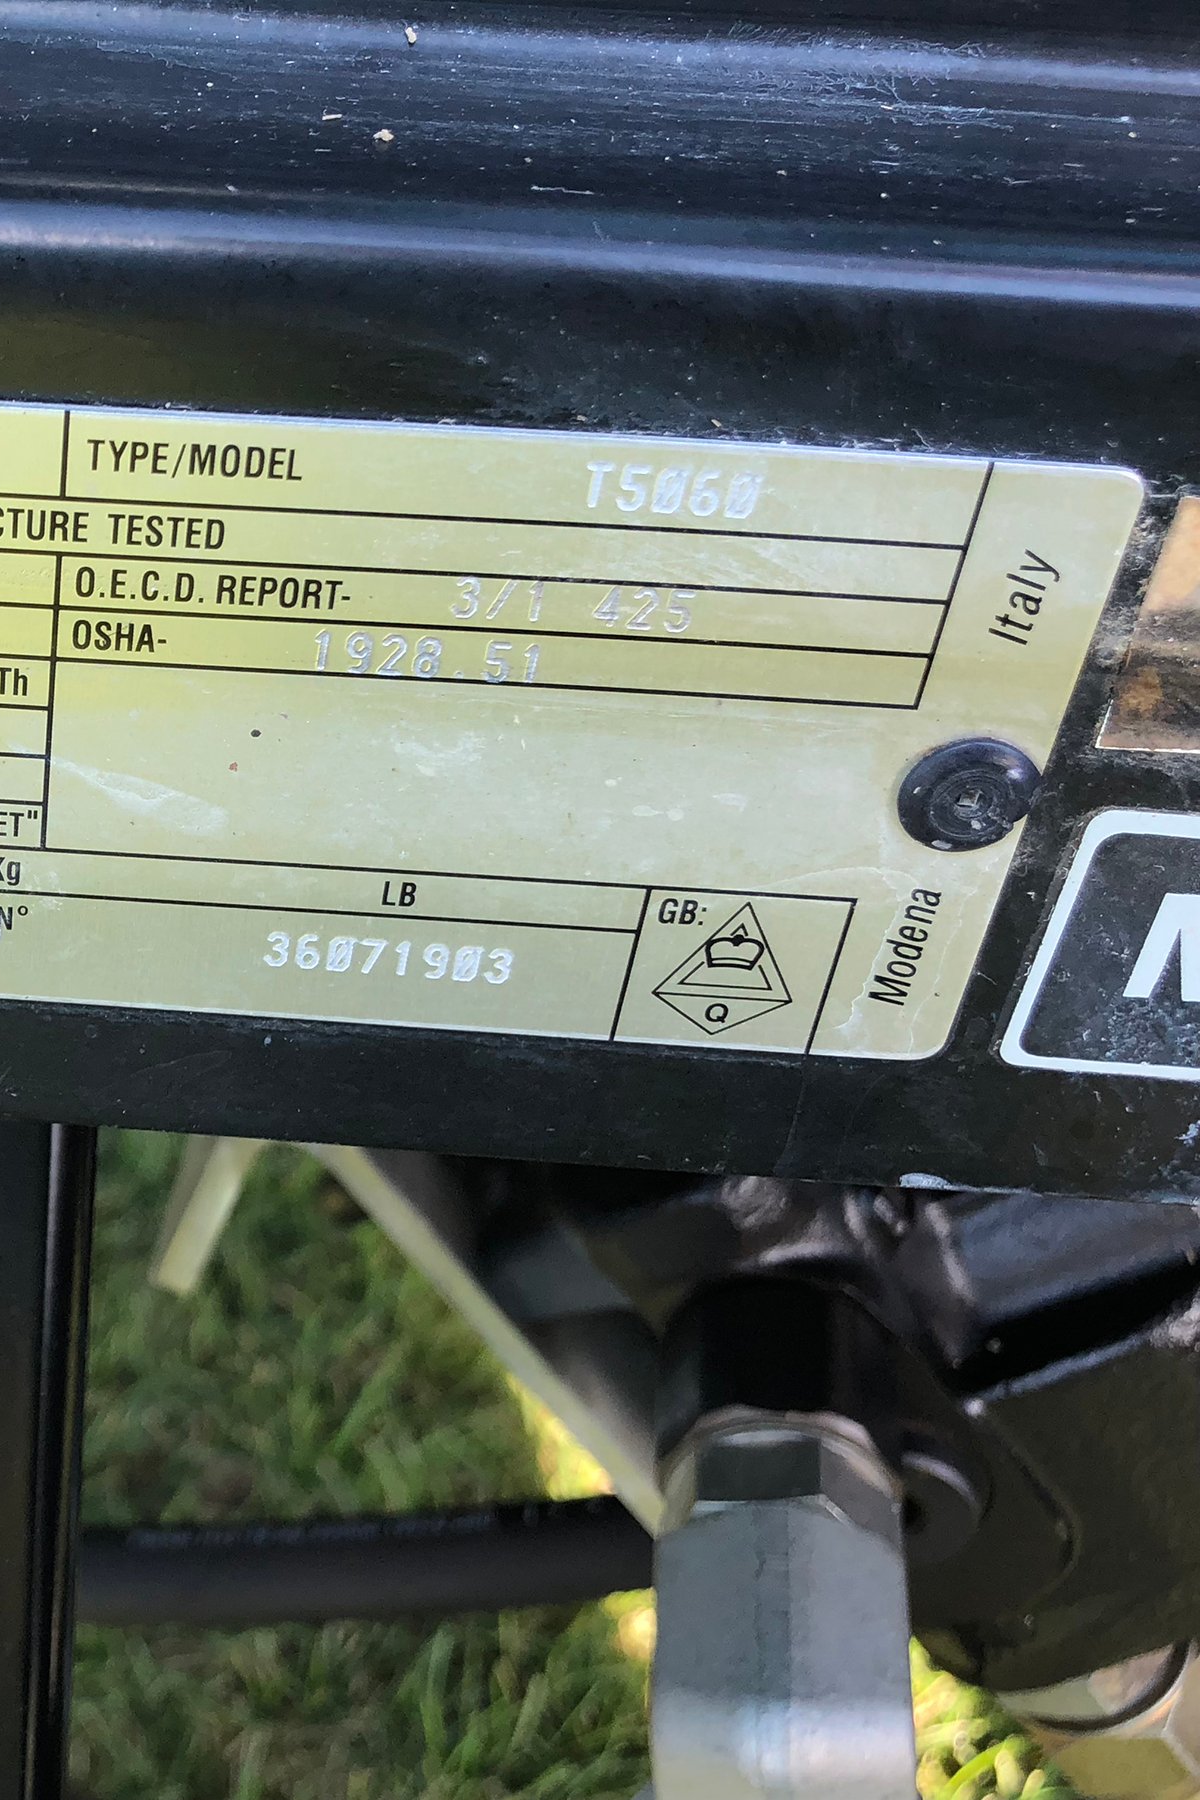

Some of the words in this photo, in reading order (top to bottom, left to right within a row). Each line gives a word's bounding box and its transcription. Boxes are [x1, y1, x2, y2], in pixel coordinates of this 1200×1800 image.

[87, 439, 303, 481] TYPE/MODEL
[107, 512, 226, 551] TESTED
[75, 565, 205, 605] O.E.C.D.
[215, 574, 352, 611] REPORT-
[592, 583, 697, 634] 425
[987, 549, 1061, 646] Italy
[72, 619, 169, 653] OSHA-
[313, 628, 542, 684] 1928.51
[381, 880, 417, 907] LB
[657, 897, 709, 928] GB:
[262, 929, 515, 984] 36071903
[868, 887, 943, 1006] Modena
[704, 1003, 731, 1027] Q
